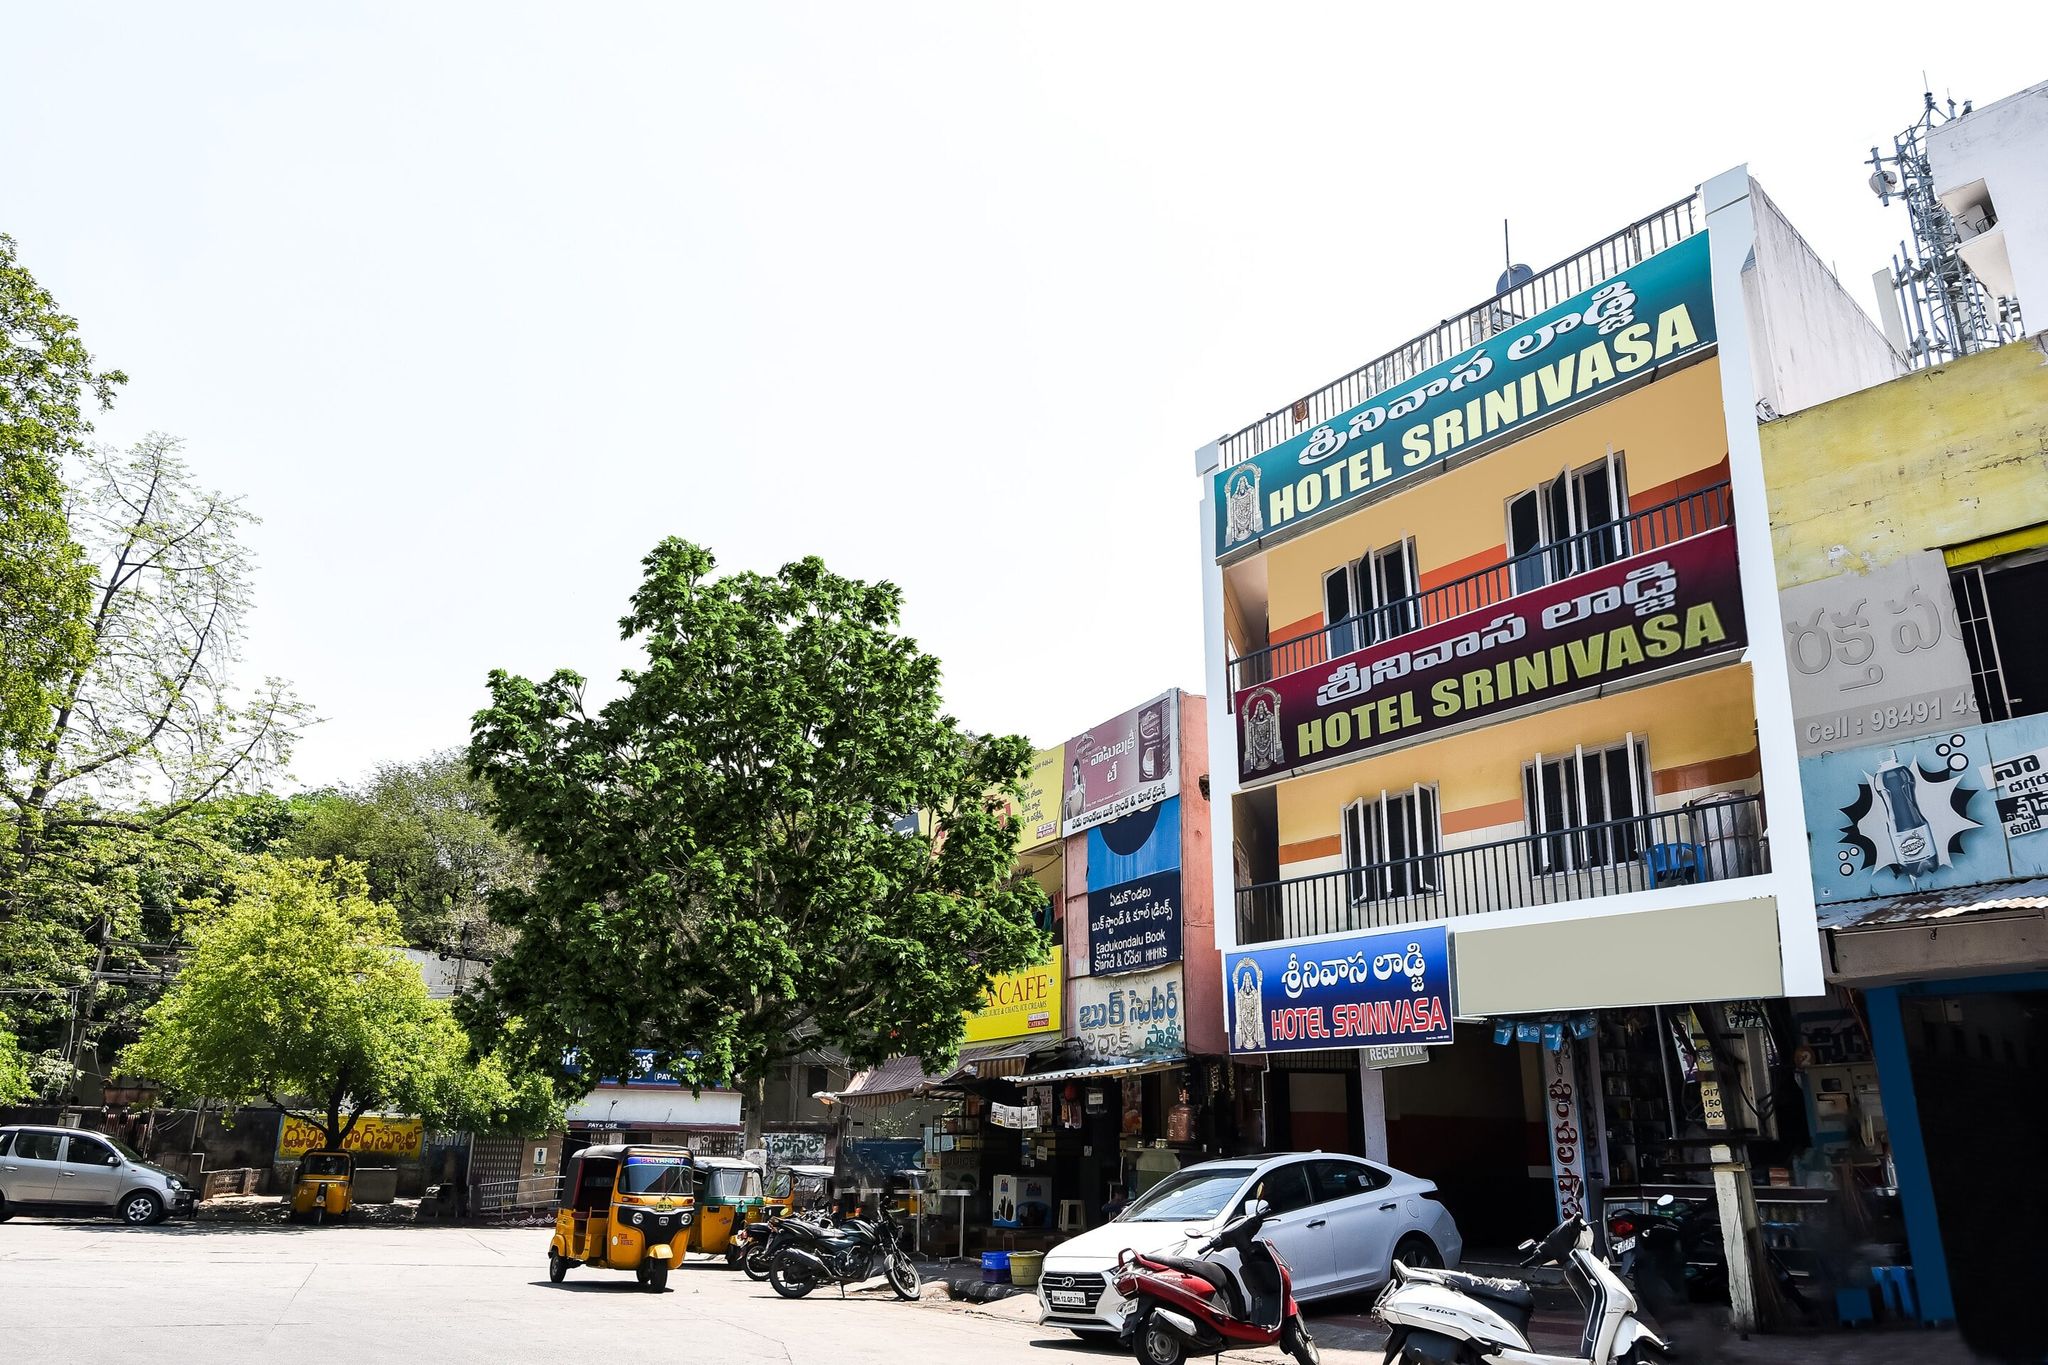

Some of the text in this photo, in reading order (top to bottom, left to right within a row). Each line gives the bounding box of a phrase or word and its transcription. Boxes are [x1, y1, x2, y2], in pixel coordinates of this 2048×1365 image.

[1298, 281, 1637, 466] శ్రీనివాస లాడ్జి
[1269, 303, 1698, 527] HOTEL SRINIVASA
[1317, 560, 1678, 707] శ్రీనివాస లాడ్జి
[1297, 602, 1726, 757] HOTEL SRINIVASA
[1807, 715, 1849, 744] Cell
[1871, 697, 1942, 732] 98491
[1125, 911, 1131, 923] &
[1096, 928, 1166, 954] Eadukondalu Book
[999, 974, 1047, 1005] CAFE
[1281, 942, 1426, 999] శ్రీనివాస లాడ్జి
[1271, 996, 1447, 1041] HOTEL SRINIVASA
[1369, 1044, 1424, 1062] RECEPTION
[1703, 1089, 1719, 1097] 017
[1705, 1099, 1721, 1108] 150
[1418, 1305, 1457, 1316] Activa
